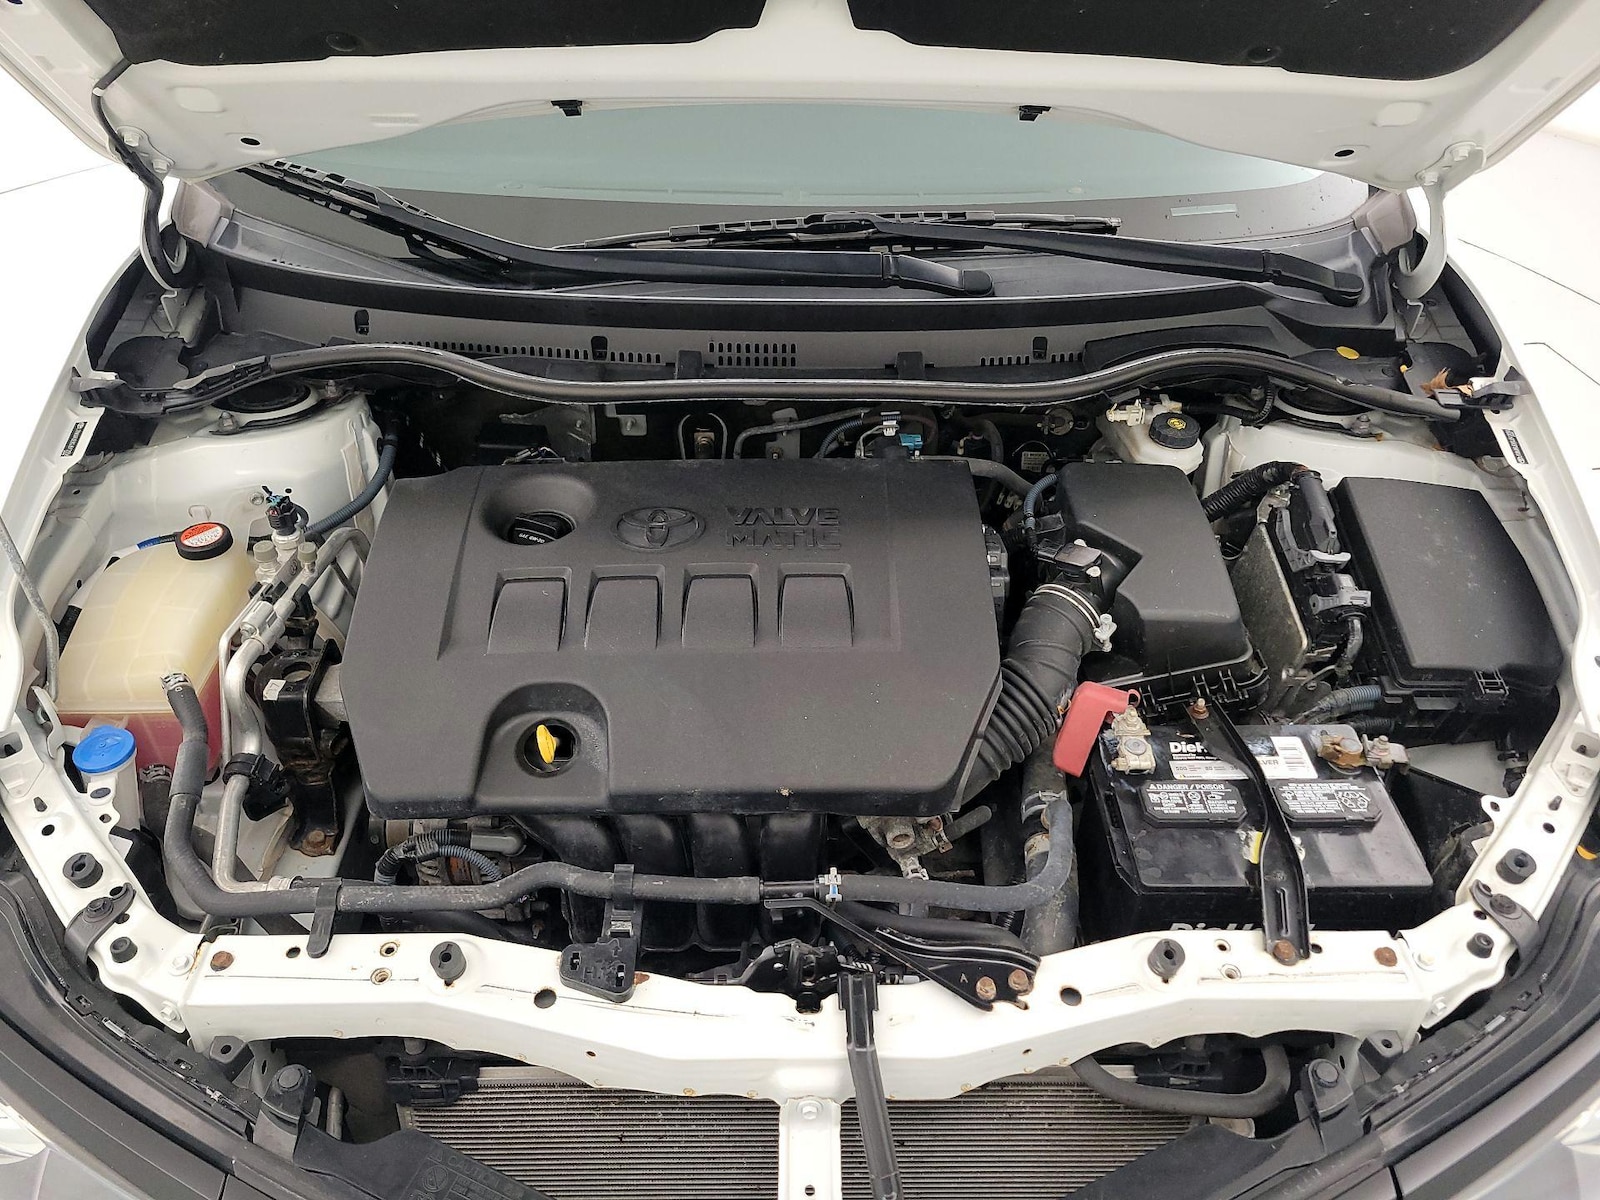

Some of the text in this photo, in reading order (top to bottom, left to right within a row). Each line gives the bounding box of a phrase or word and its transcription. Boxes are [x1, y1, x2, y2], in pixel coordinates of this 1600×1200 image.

[727, 507, 841, 526] VALVE
[726, 527, 841, 550] MATIC
[1169, 741, 1208, 753] DieH
